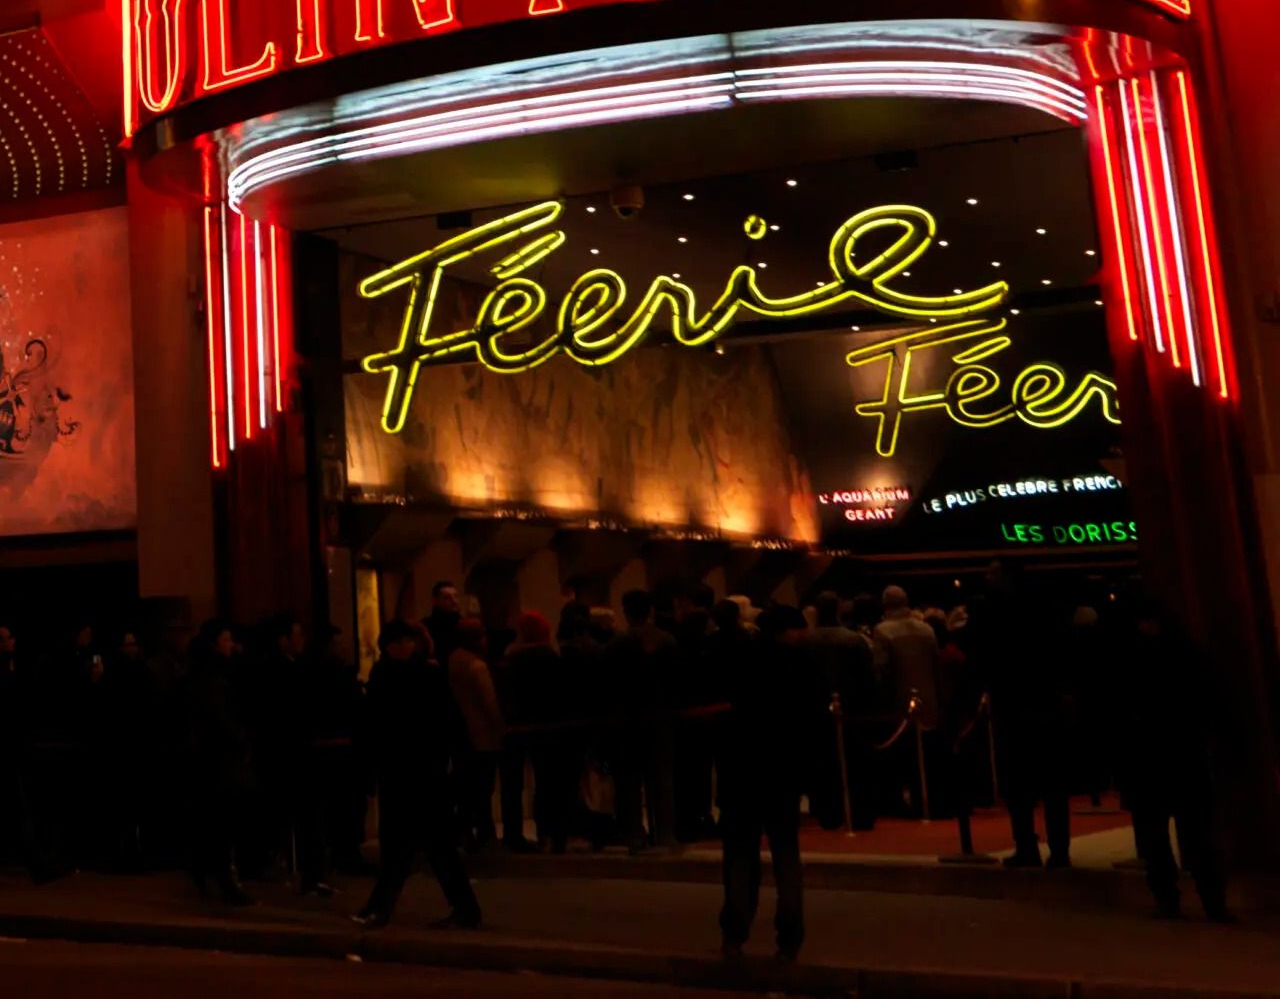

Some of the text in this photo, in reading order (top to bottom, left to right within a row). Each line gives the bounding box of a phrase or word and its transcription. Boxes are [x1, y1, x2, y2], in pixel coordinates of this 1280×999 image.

[358, 201, 1010, 434] Féerie
[922, 498, 943, 515] LE
[944, 488, 986, 510] PLUS
[988, 480, 1060, 498] CELEBRE
[844, 507, 896, 522] GEANT
[1001, 522, 1045, 543] LES
